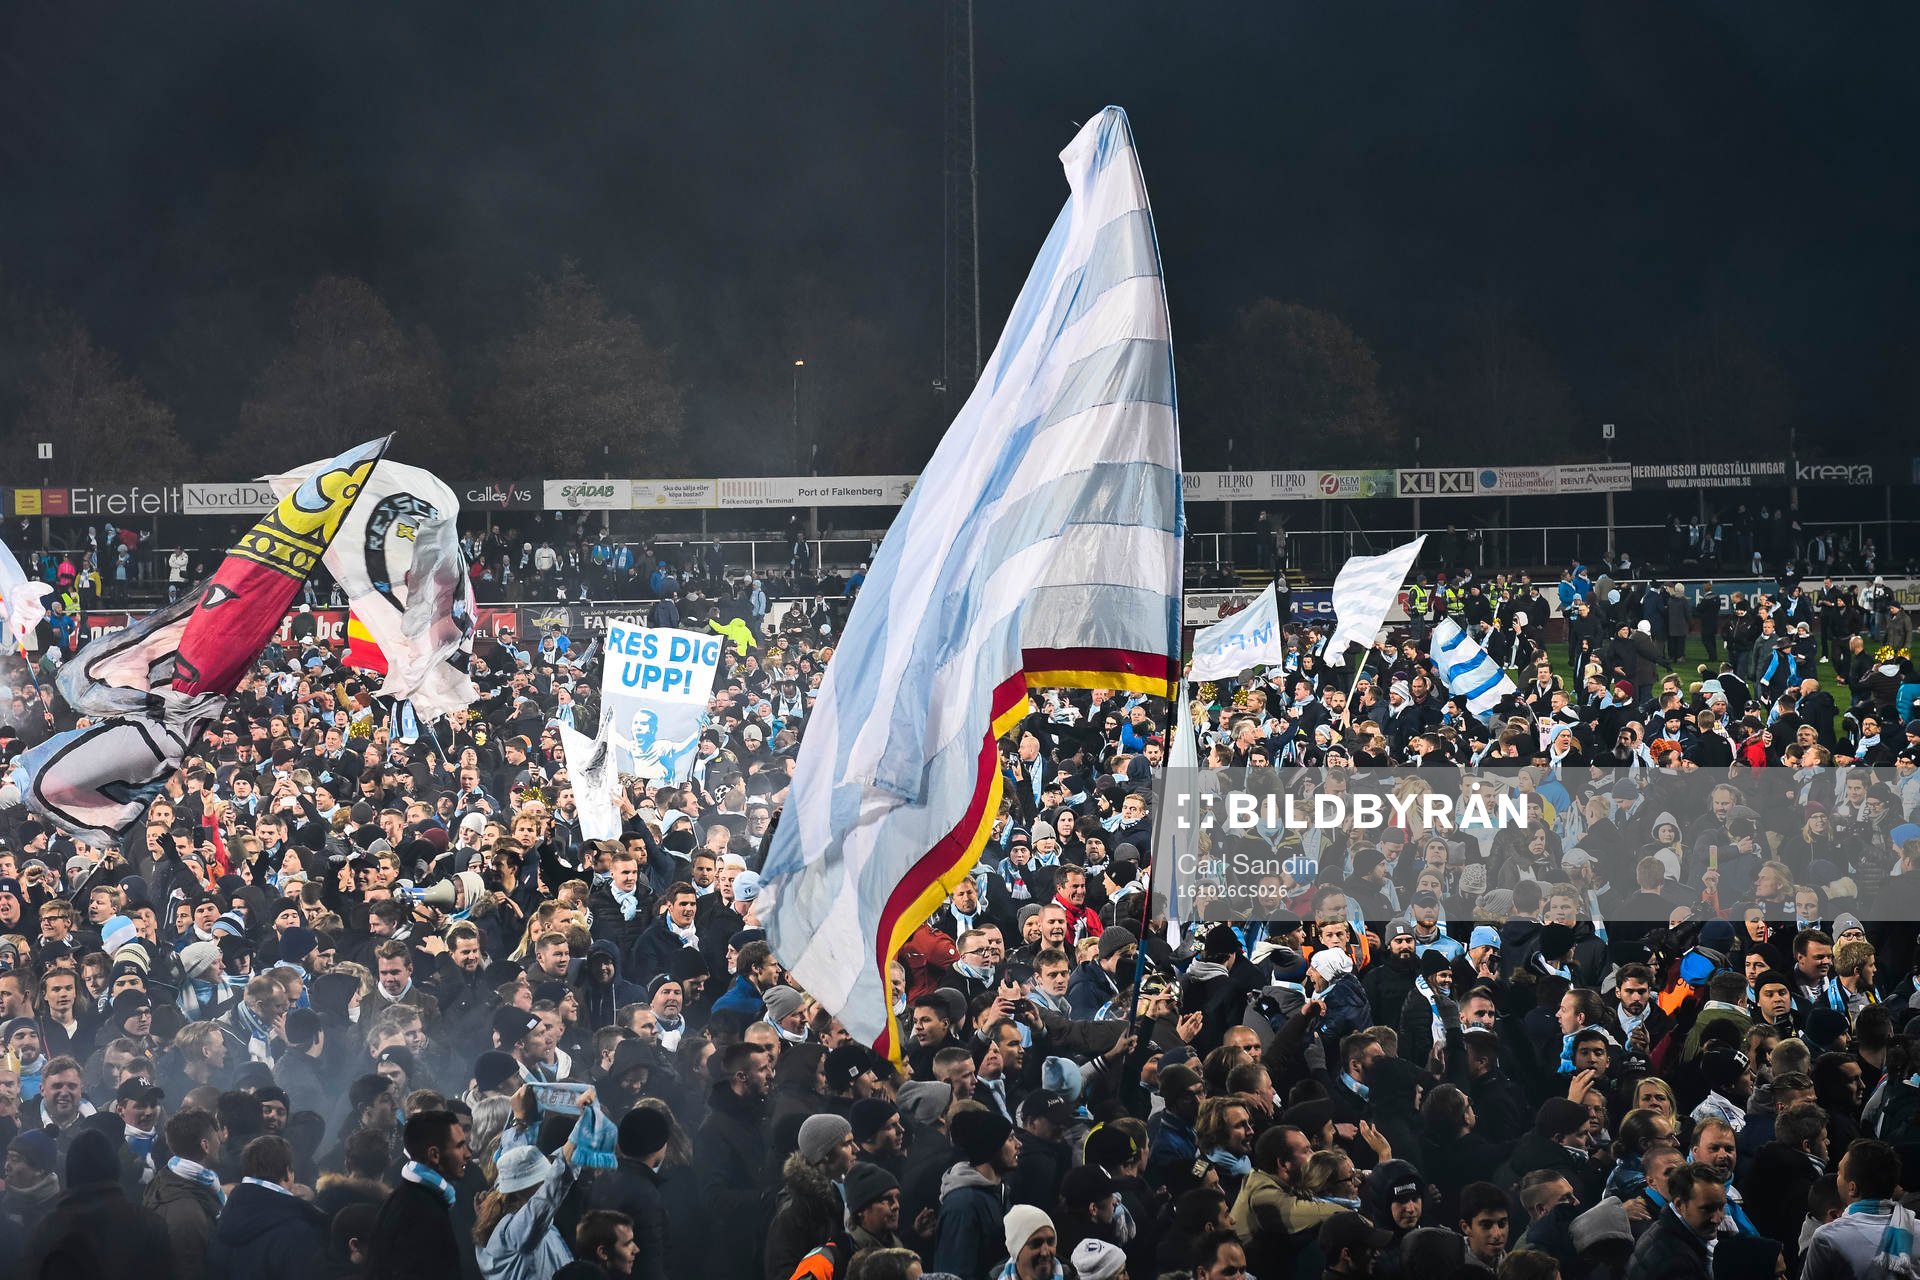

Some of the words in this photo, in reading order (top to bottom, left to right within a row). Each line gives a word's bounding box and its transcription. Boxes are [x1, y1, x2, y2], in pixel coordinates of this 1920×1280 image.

[1499, 470, 1540, 478] Svenssons
[1632, 464, 1697, 478] HERMANSSON
[1700, 461, 1785, 476] BYGGSTÄLLNINGAR
[1796, 460, 1872, 480] kreera
[1182, 474, 1200, 488] PRO
[1218, 474, 1253, 488] FILPRO
[1271, 474, 1306, 488] FILPRO
[1340, 476, 1359, 485] KEM
[1402, 474, 1433, 492] XL
[1440, 473, 1472, 492] XL
[1499, 478, 1554, 488] Fritidsmöbler
[71, 487, 180, 514] Eirefelt
[187, 488, 280, 506] NordDes
[466, 486, 508, 502] Calles
[798, 488, 818, 496] Port
[820, 488, 828, 496] of
[832, 487, 882, 498] Falkenberg
[608, 627, 658, 659] RES
[669, 636, 719, 666] DIG
[622, 662, 693, 694] UPP!
